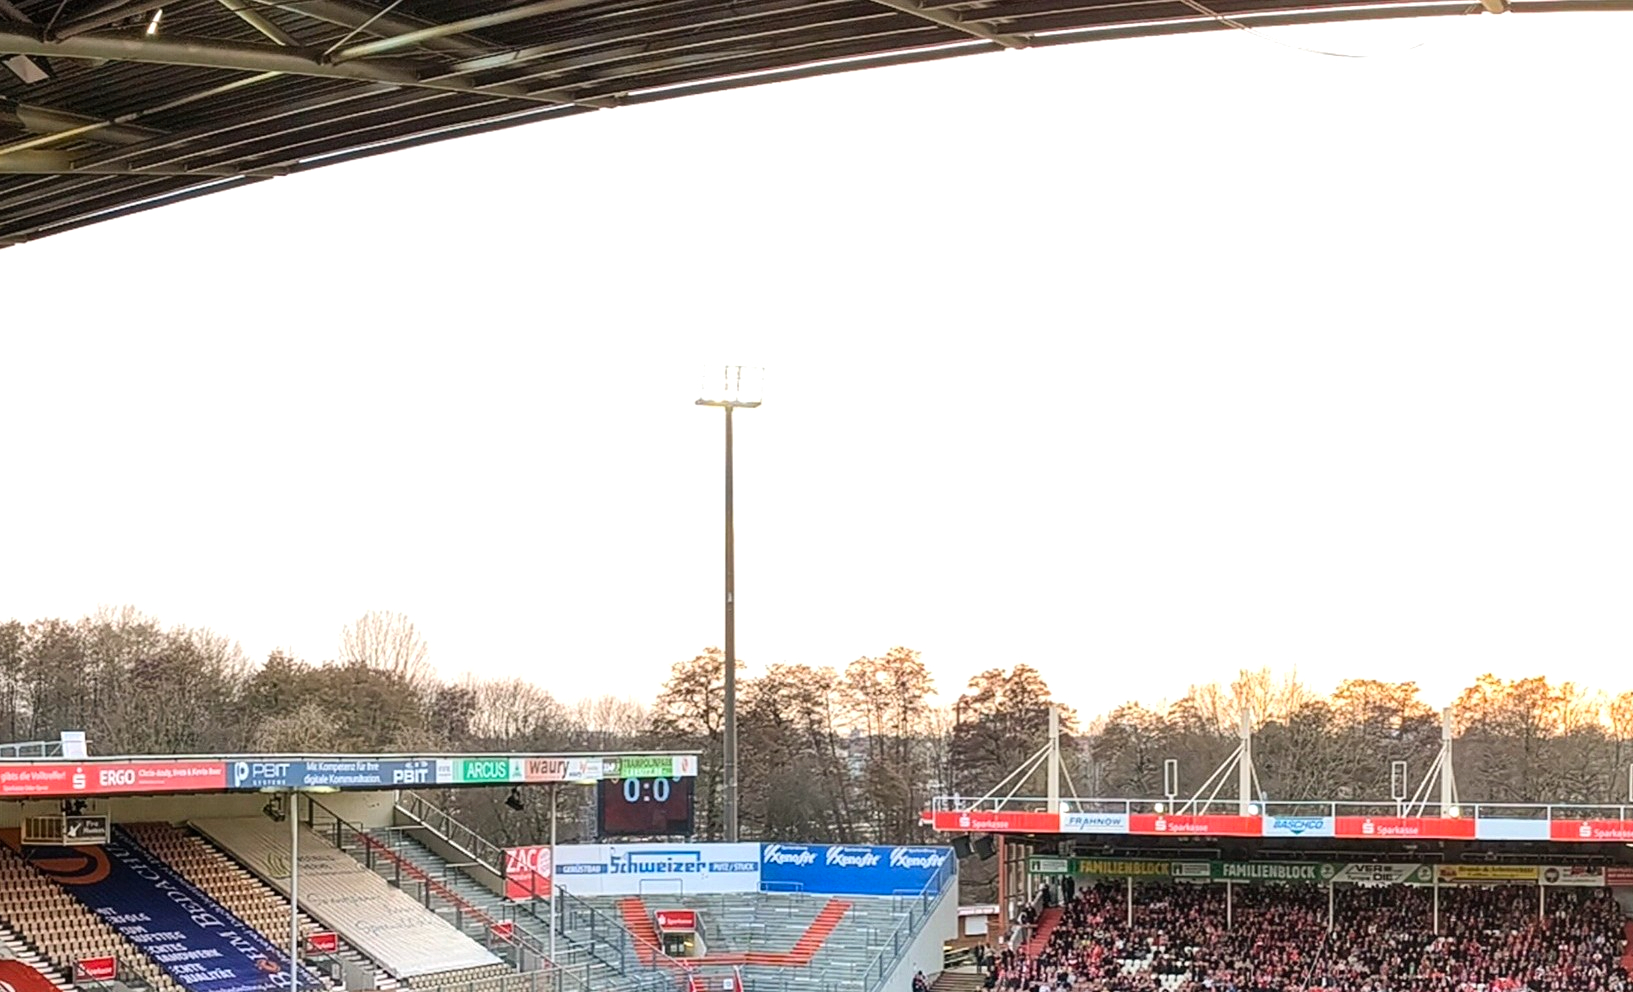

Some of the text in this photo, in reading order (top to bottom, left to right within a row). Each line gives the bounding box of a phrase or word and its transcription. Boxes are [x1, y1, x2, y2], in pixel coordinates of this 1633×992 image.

[253, 763, 290, 778] PBIT
[393, 769, 428, 783] PBIT
[466, 761, 507, 778] ARCUS
[529, 759, 569, 779] waury
[99, 769, 135, 787] ERGO
[972, 820, 1008, 829] Sparkasse
[1069, 817, 1121, 829] FRAHNOW
[1169, 822, 1208, 833] Sparkasse
[1273, 818, 1323, 829] BASCHCO
[1377, 825, 1419, 835] Sparkasse
[505, 848, 537, 873] ZAC
[611, 852, 707, 874] Schweizer
[765, 846, 817, 867] Xenofit
[826, 847, 882, 867] Xenofit
[1079, 860, 1170, 874] FAMILIENBLOCK
[1222, 864, 1316, 879] FAMILIENBLOCK
